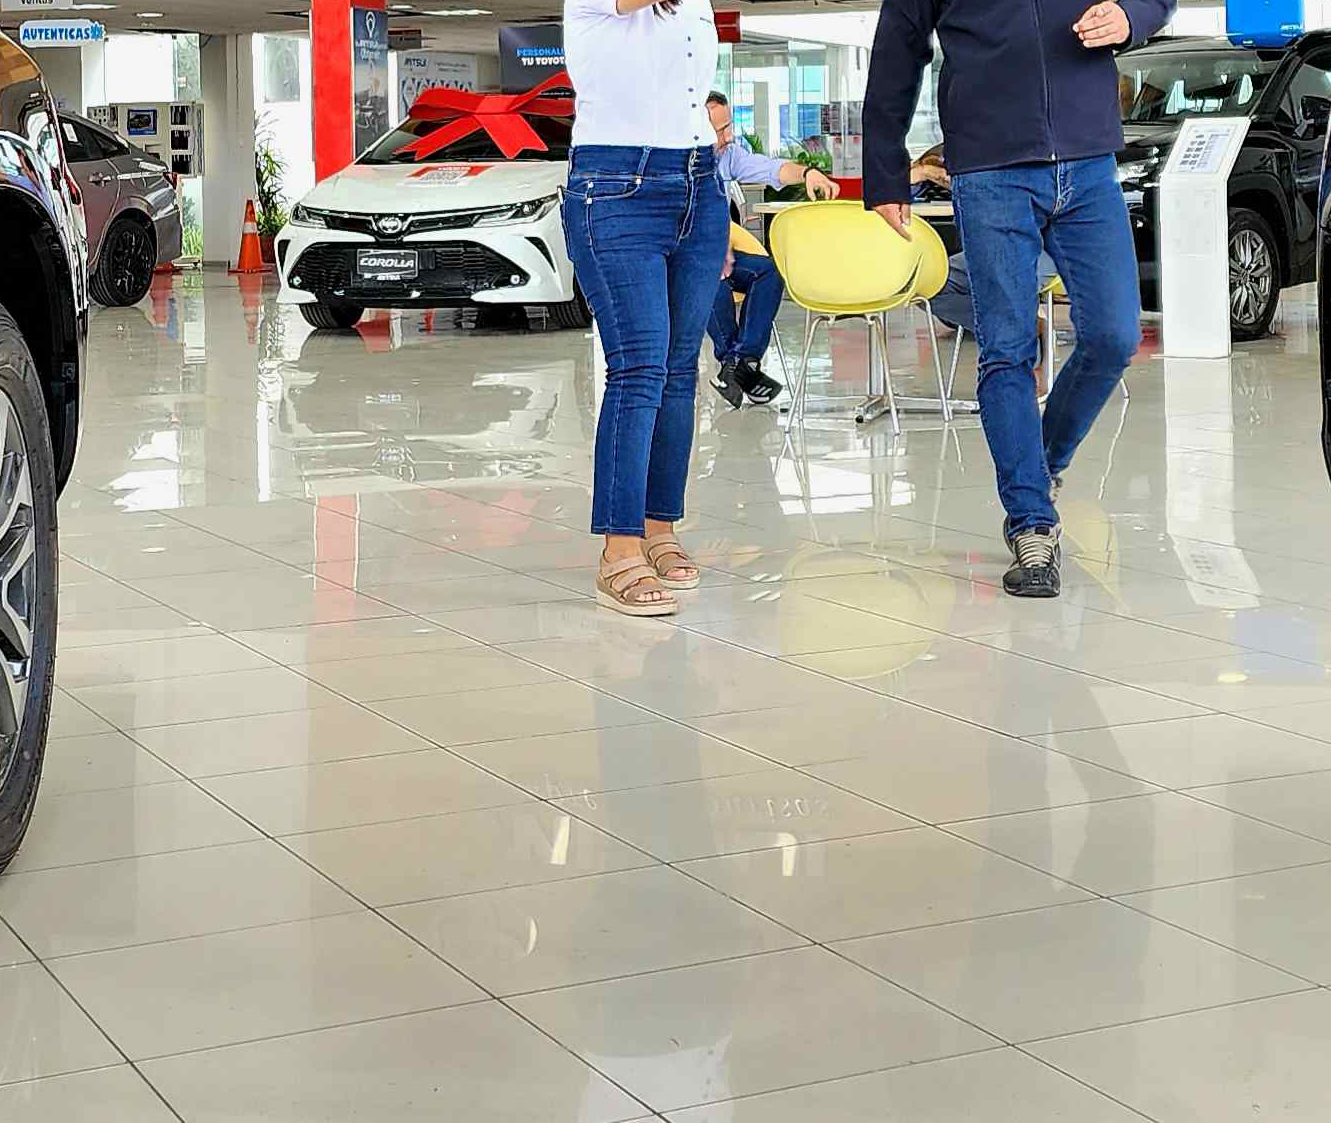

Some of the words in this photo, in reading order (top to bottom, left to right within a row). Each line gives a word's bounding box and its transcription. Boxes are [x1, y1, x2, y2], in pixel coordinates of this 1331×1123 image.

[22, 27, 90, 41] AUTENTICAS
[521, 56, 535, 66] TU
[535, 56, 566, 66] TOYOT
[359, 257, 415, 268] COROLLA
